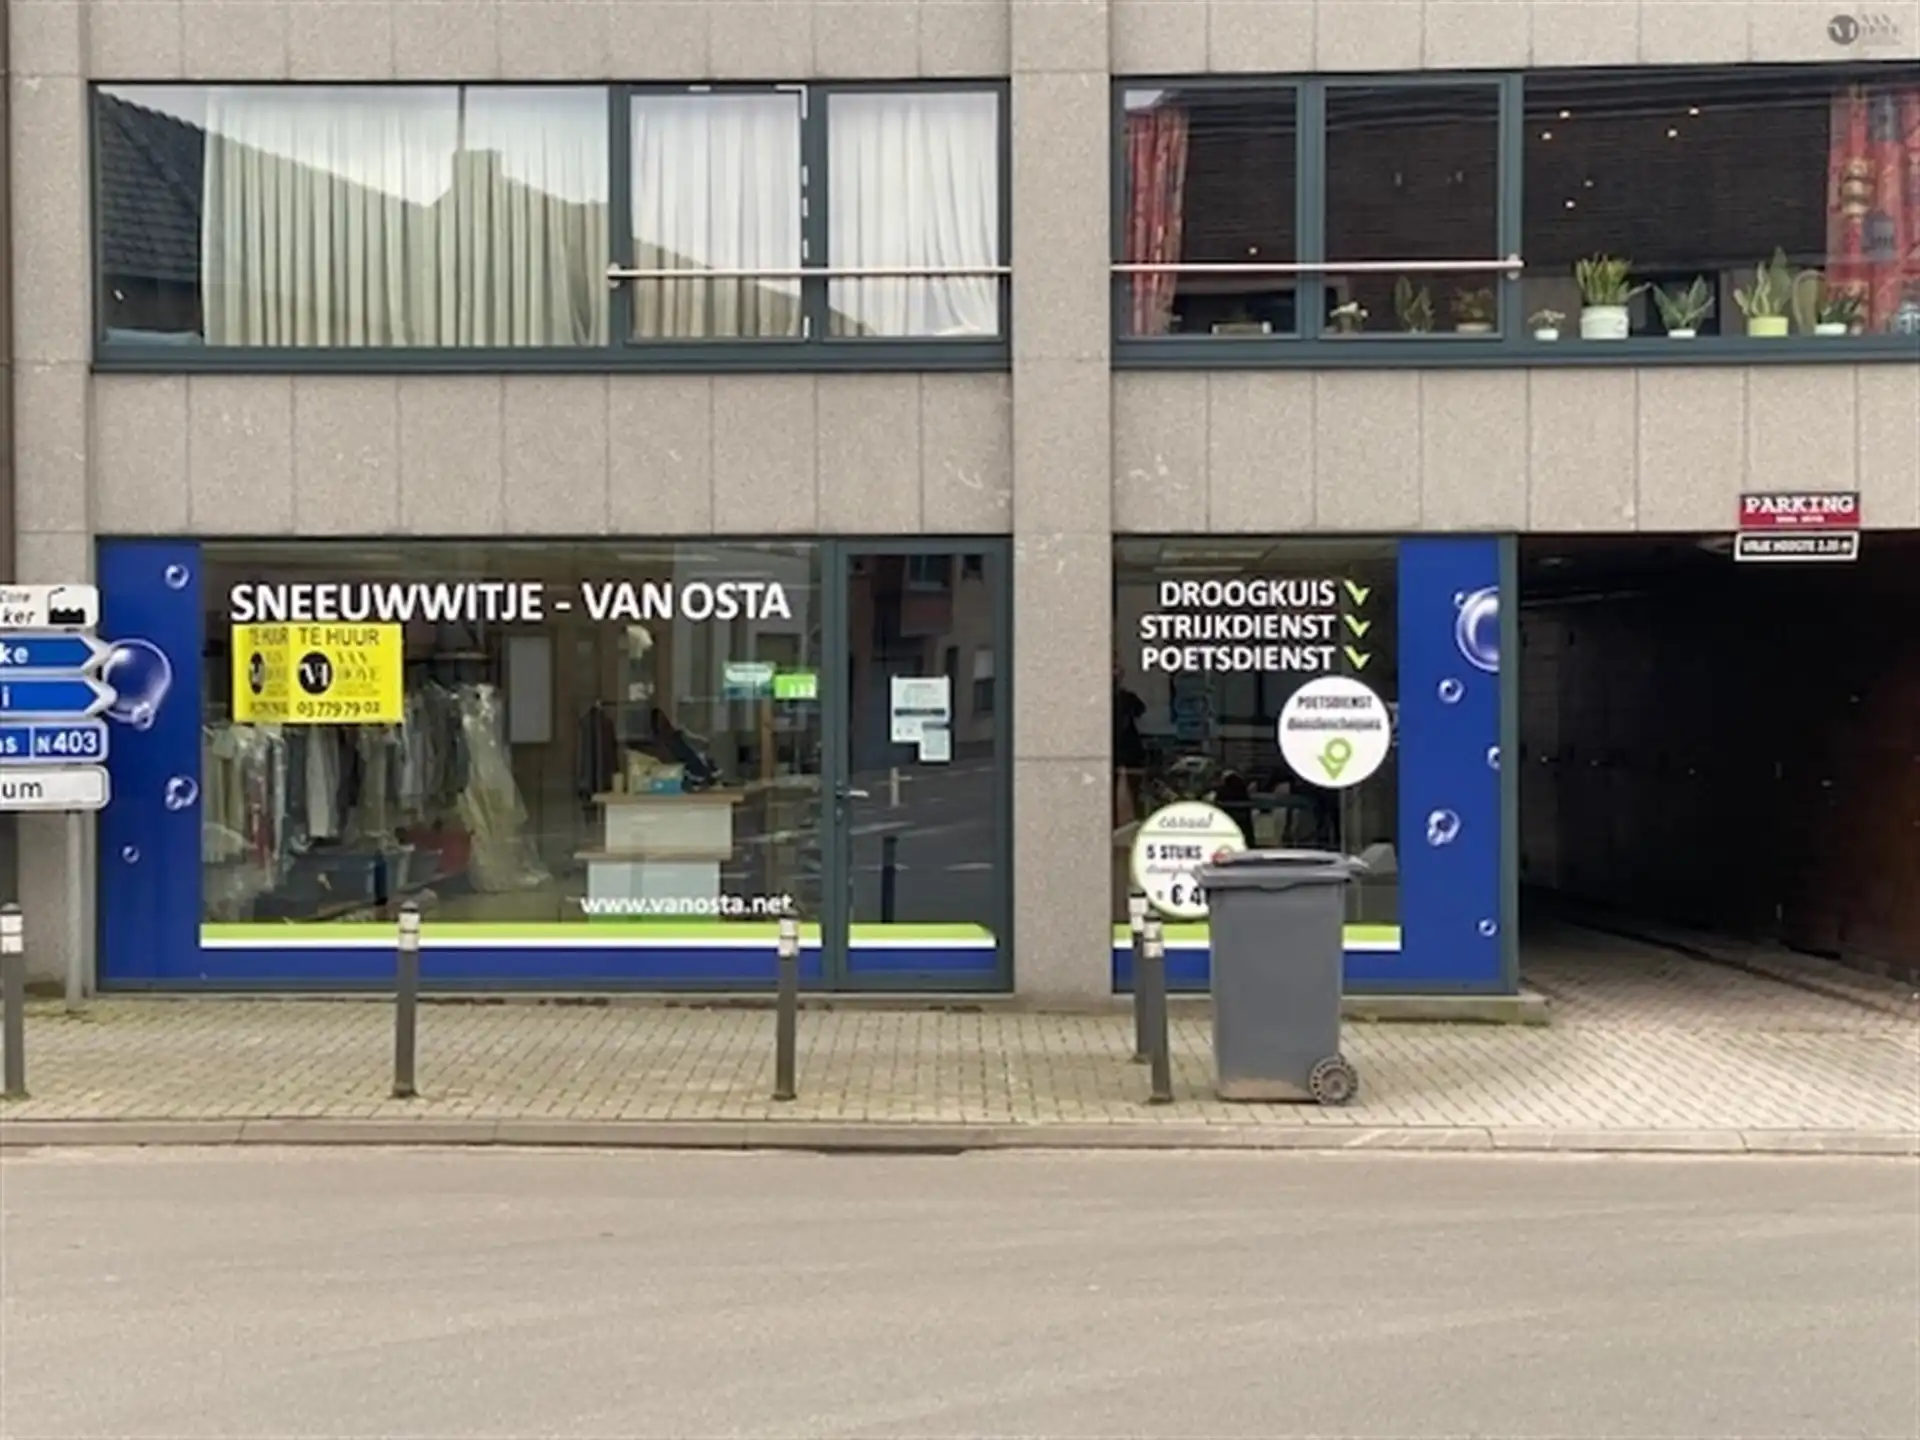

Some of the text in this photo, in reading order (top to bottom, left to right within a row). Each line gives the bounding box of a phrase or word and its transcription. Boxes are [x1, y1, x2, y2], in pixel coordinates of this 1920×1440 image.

[1745, 495, 1855, 514] PARKING
[230, 582, 792, 622] SNEEUWWITJE - VAN OSTA
[1160, 580, 1336, 608] DROOGKUIS
[298, 626, 380, 646] TE HUUR
[1140, 614, 1336, 640] STRIJKDIENST
[1141, 646, 1336, 671] POETSDIENST
[1297, 695, 1373, 710] POETSDIENST
[36, 730, 98, 754] N403
[1146, 843, 1203, 860] 5 STUKS
[579, 894, 794, 915] www.vanosta.net
